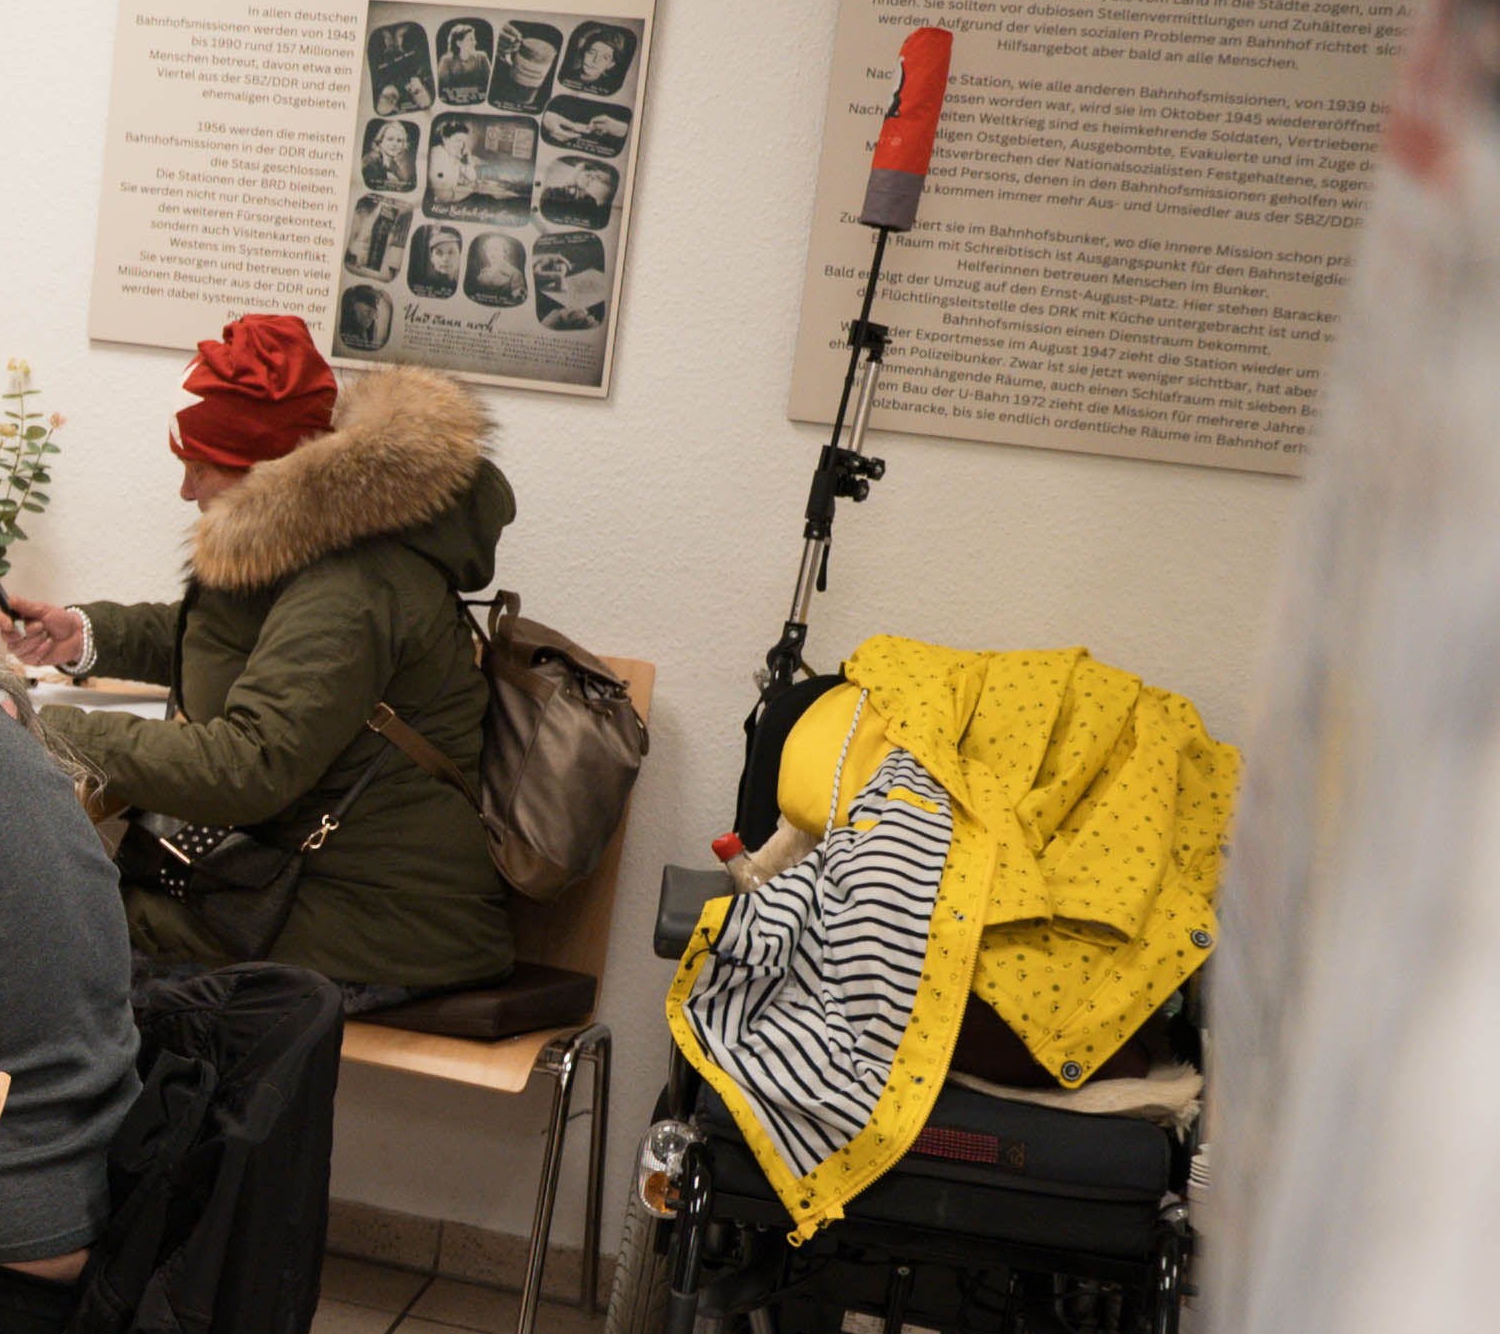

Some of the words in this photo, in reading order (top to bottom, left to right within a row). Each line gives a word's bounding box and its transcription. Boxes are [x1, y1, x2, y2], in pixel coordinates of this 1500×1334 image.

[135, 14, 250, 33] Bahnhofsmissionen
[253, 24, 297, 36] werden
[300, 28, 323, 38] von
[327, 28, 356, 41] 1945
[247, 6, 259, 16] In
[261, 7, 291, 19] allen
[294, 9, 357, 24] deutschen
[956, 258, 1039, 277] Helferinnen
[1042, 266, 1108, 283] betreuen
[1112, 272, 1187, 290] Menschen
[1190, 280, 1209, 292] im
[1212, 282, 1268, 298] Bunker.
